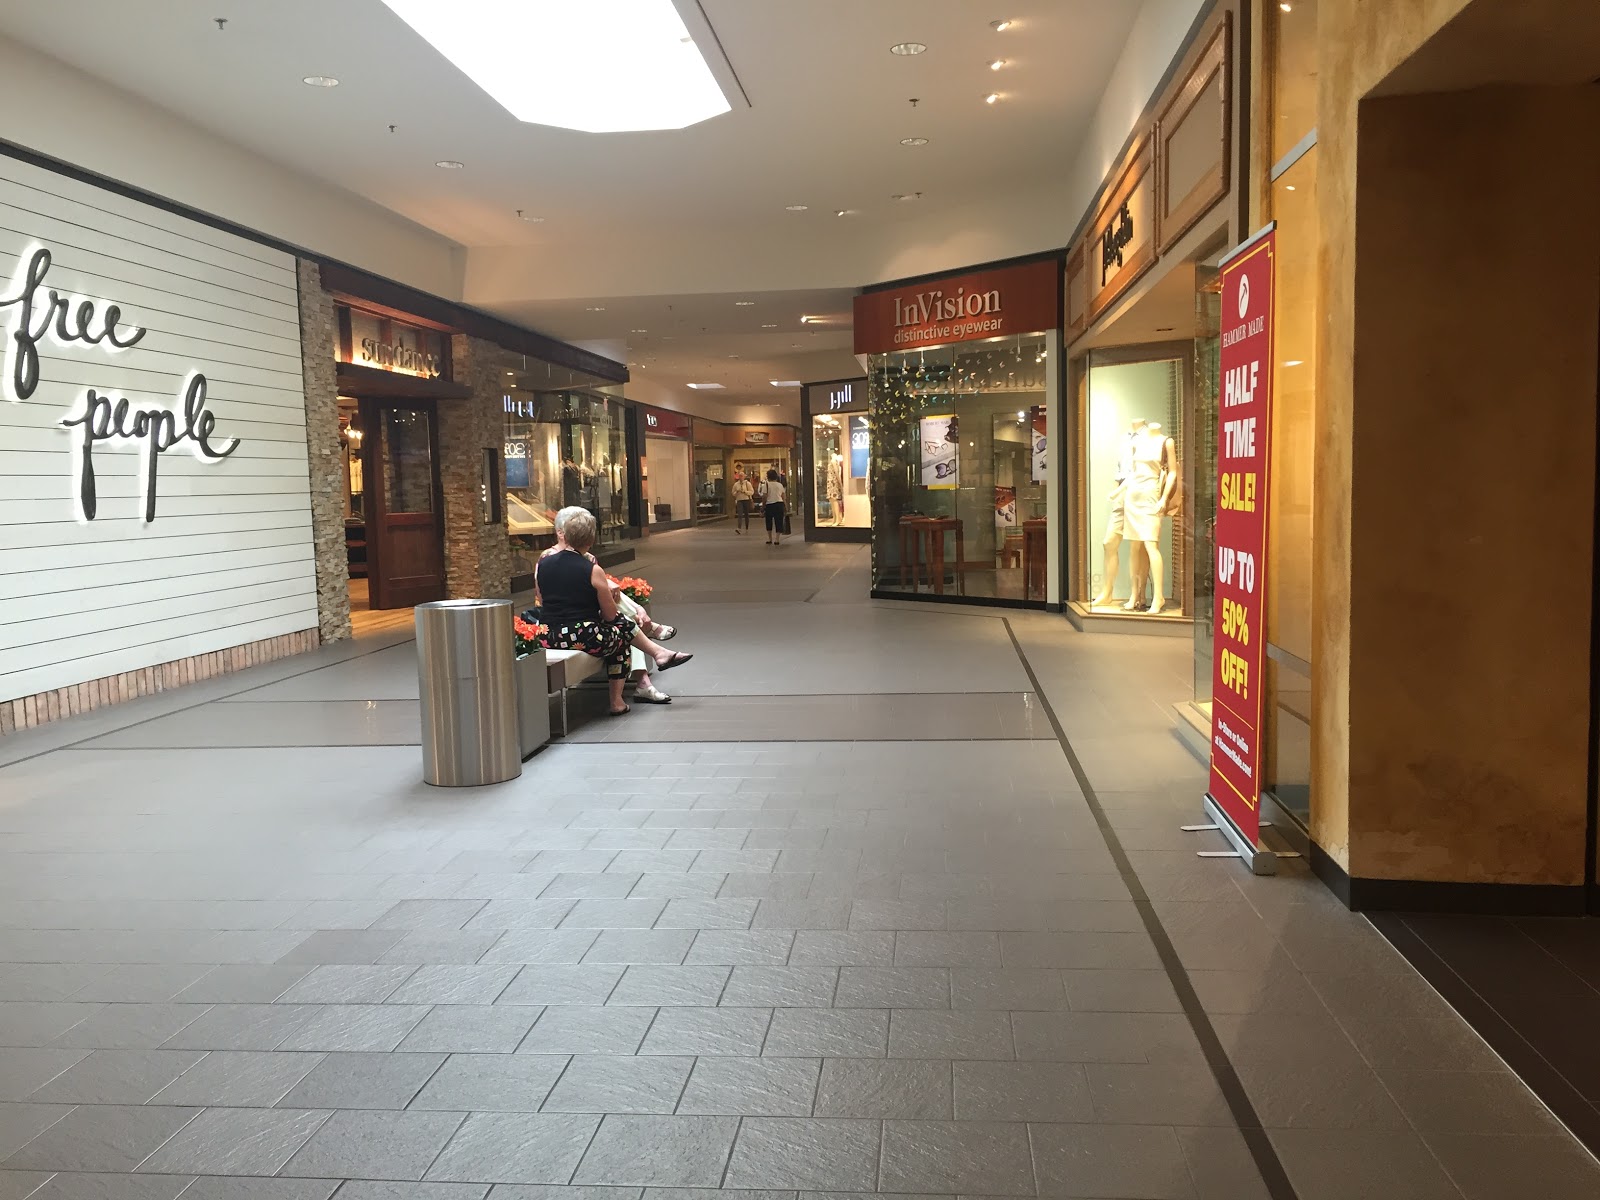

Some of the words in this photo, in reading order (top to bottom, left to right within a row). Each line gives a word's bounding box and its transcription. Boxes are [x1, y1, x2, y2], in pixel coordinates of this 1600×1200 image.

[0, 248, 146, 400] free
[894, 287, 1001, 327] InVision
[894, 325, 950, 343] distinctive
[952, 318, 1003, 338] eyewear
[1222, 324, 1246, 348] HAMMER
[1248, 315, 1265, 338] MADE
[1224, 360, 1259, 408] HALF
[58, 373, 241, 522] people
[1224, 417, 1257, 459] TIME
[1220, 472, 1257, 513] SALE!
[1218, 546, 1235, 585] UP
[1237, 551, 1255, 594] TO
[1221, 597, 1249, 646] 50%
[1220, 647, 1249, 700] OFF!
